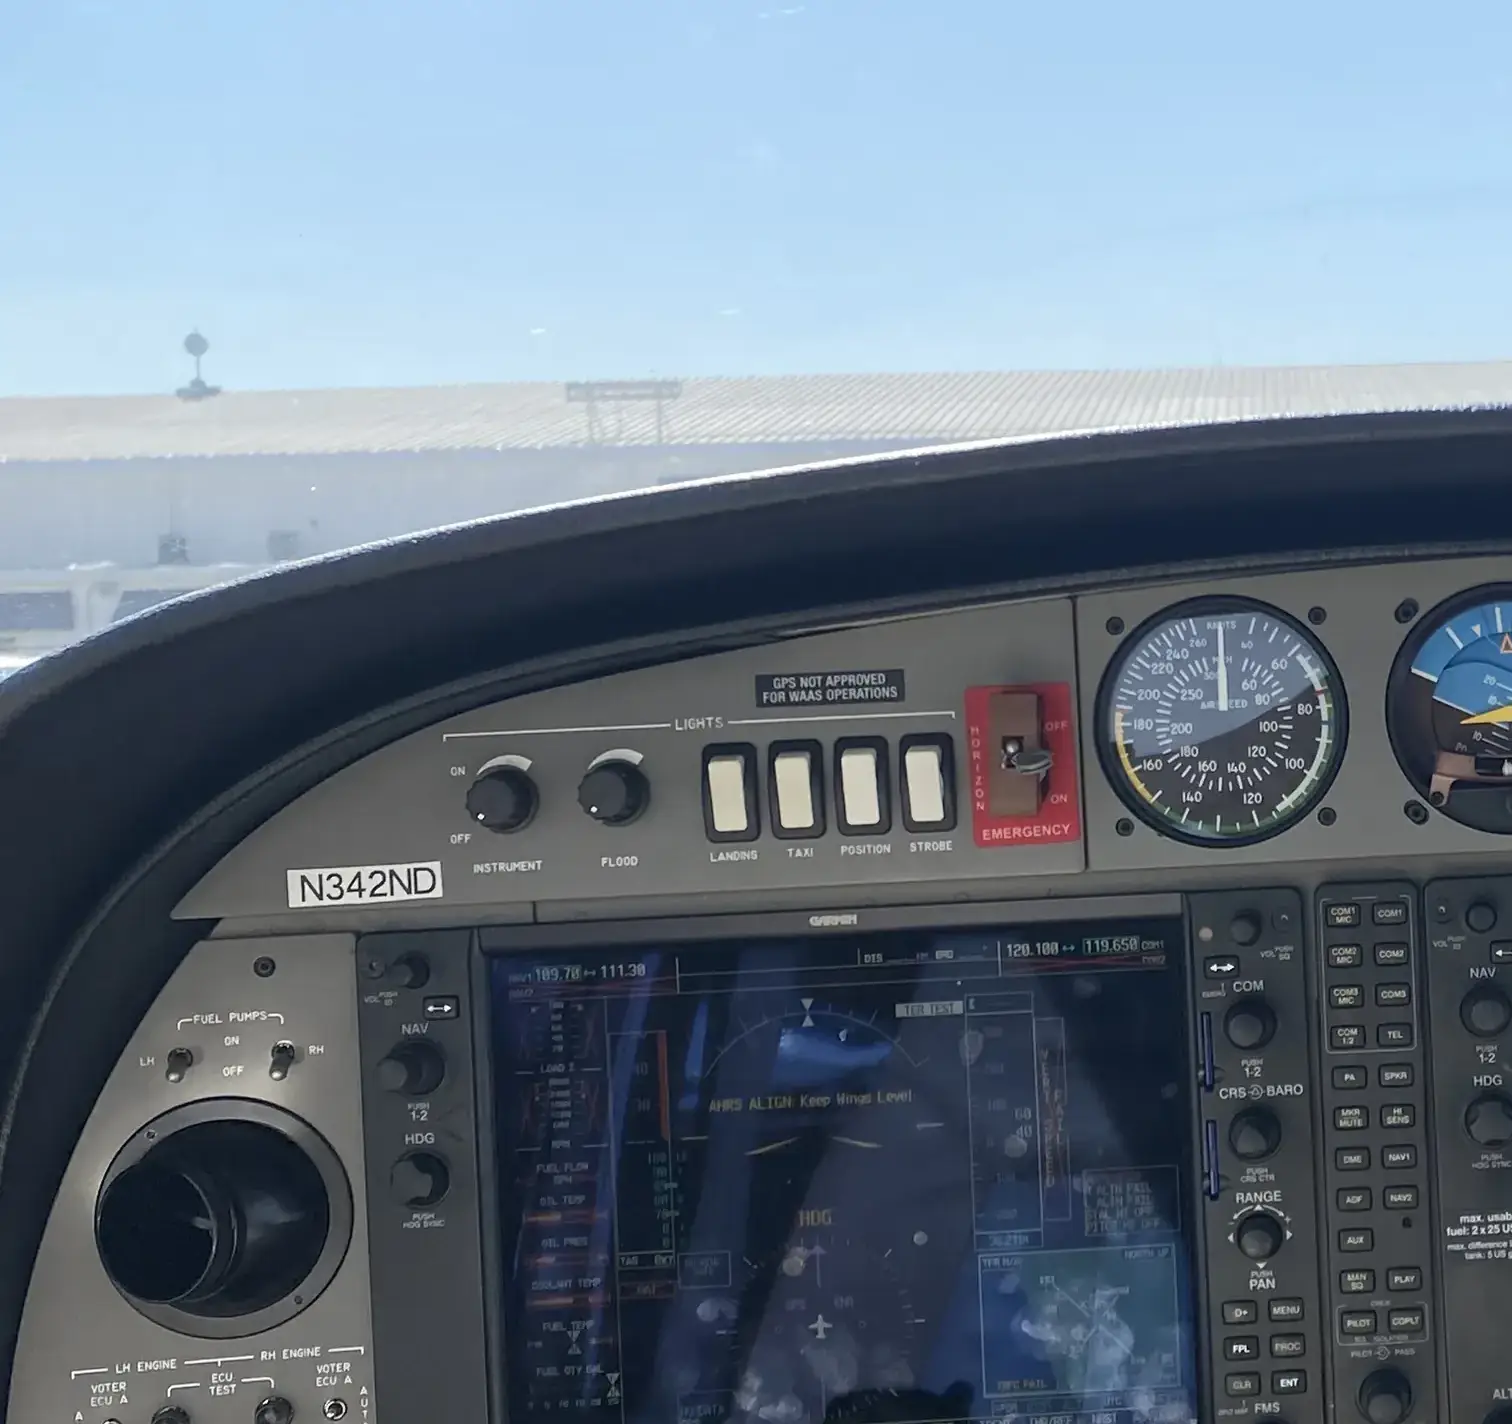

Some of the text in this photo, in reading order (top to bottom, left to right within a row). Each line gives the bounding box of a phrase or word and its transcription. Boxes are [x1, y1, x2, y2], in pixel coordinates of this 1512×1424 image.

[1166, 649, 1189, 660] 240
[1151, 663, 1173, 674] 220
[773, 674, 885, 689] GPS NOT APPROVED
[763, 686, 897, 703] FOR WAAS OPERATIONS
[1137, 689, 1160, 700] 200
[675, 717, 723, 730] LIGHTS
[970, 726, 985, 811] HORIZON
[1143, 760, 1162, 770] 160
[1285, 759, 1304, 769] 100
[1182, 792, 1202, 802] 140
[1243, 793, 1262, 803] 120
[982, 824, 1071, 841] EMERGENCY
[841, 844, 891, 855] POSITION
[910, 841, 952, 852] STROBE
[710, 851, 758, 862] LANDING
[787, 848, 814, 858] TAXI
[601, 856, 638, 867] FLOOD
[473, 861, 542, 874] INSTRUMENT
[301, 867, 436, 902] N342ND
[809, 914, 857, 927] GARMIN
[1006, 938, 1138, 957] 120.100 119.650
[535, 963, 646, 982] 109.70 111.30
[1469, 967, 1496, 978] NAV
[1233, 980, 1264, 992] COM
[193, 1011, 268, 1024] FUEL PUMPS
[1473, 1075, 1502, 1086] HDG
[1219, 1084, 1303, 1099] CRS BARO
[405, 1133, 434, 1145] HDG
[1236, 1191, 1282, 1203] RANGE
[1459, 1214, 1483, 1222] max.
[1446, 1226, 1469, 1236] fuel:
[1472, 1226, 1478, 1235] 2
[1488, 1225, 1500, 1234] 25
[1249, 1278, 1275, 1290] PAN
[260, 1347, 321, 1361] RH ENGINE
[115, 1359, 177, 1374] LH ENGINE
[316, 1363, 350, 1374] VOTER
[1280, 1378, 1298, 1388] ENT
[1254, 1403, 1280, 1414] FMS
